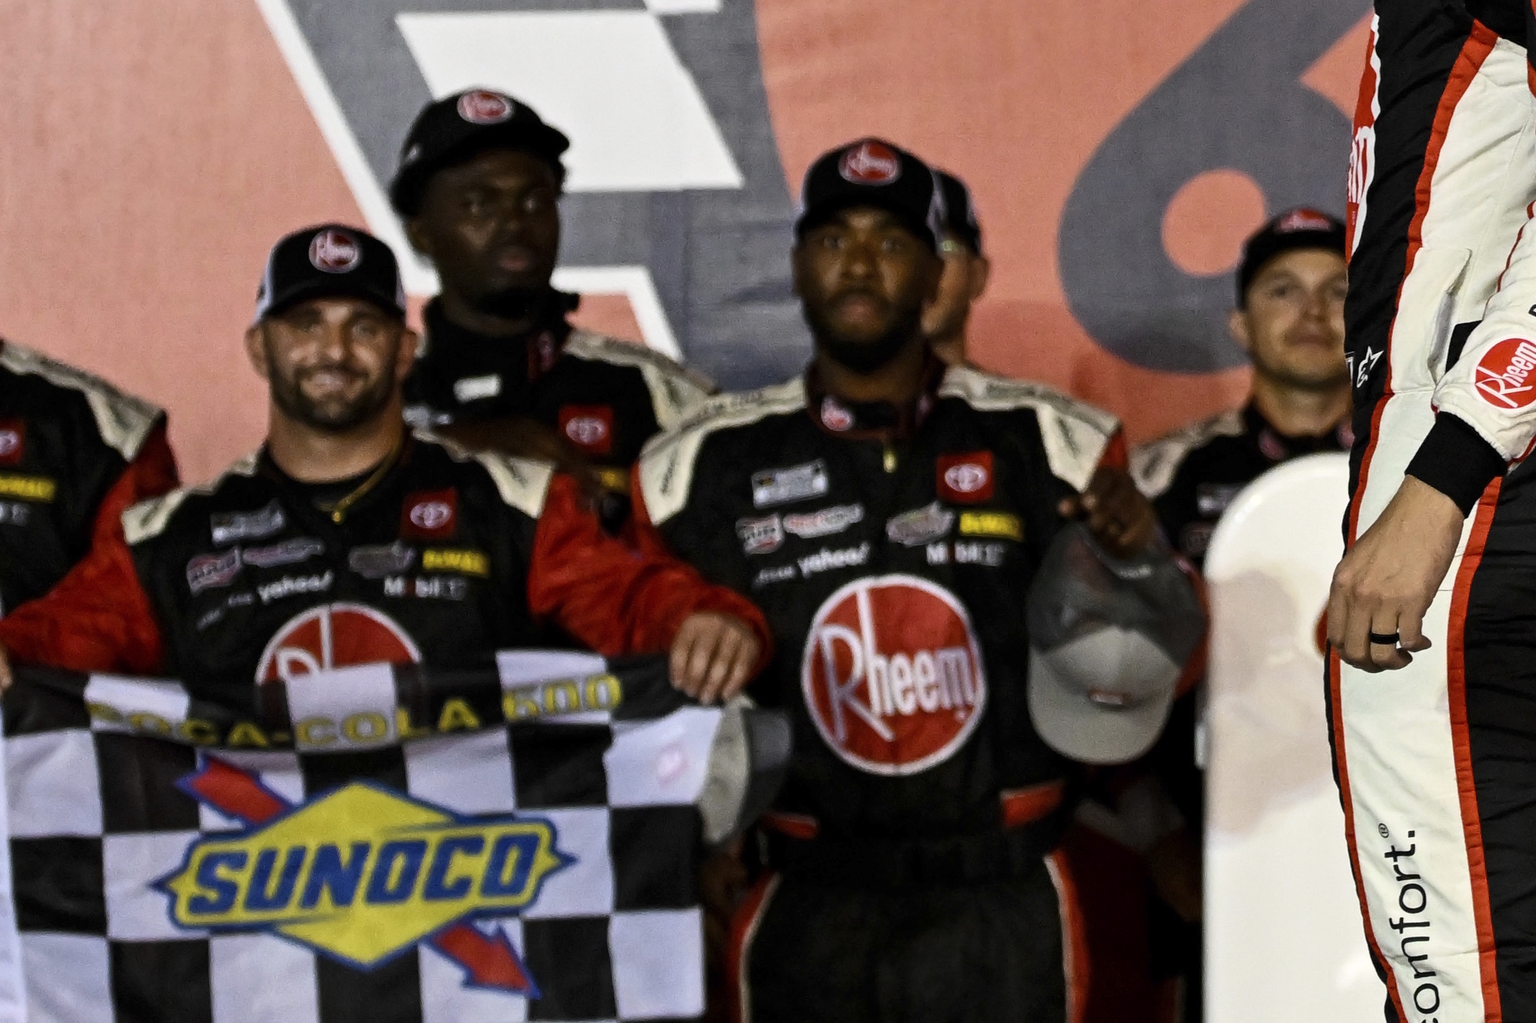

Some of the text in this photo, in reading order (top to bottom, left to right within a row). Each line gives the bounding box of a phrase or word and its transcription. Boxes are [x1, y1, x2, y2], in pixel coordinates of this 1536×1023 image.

[818, 585, 977, 743] Rheem
[187, 831, 542, 915] SUNOCO
[1384, 829, 1441, 1023] omfort.
